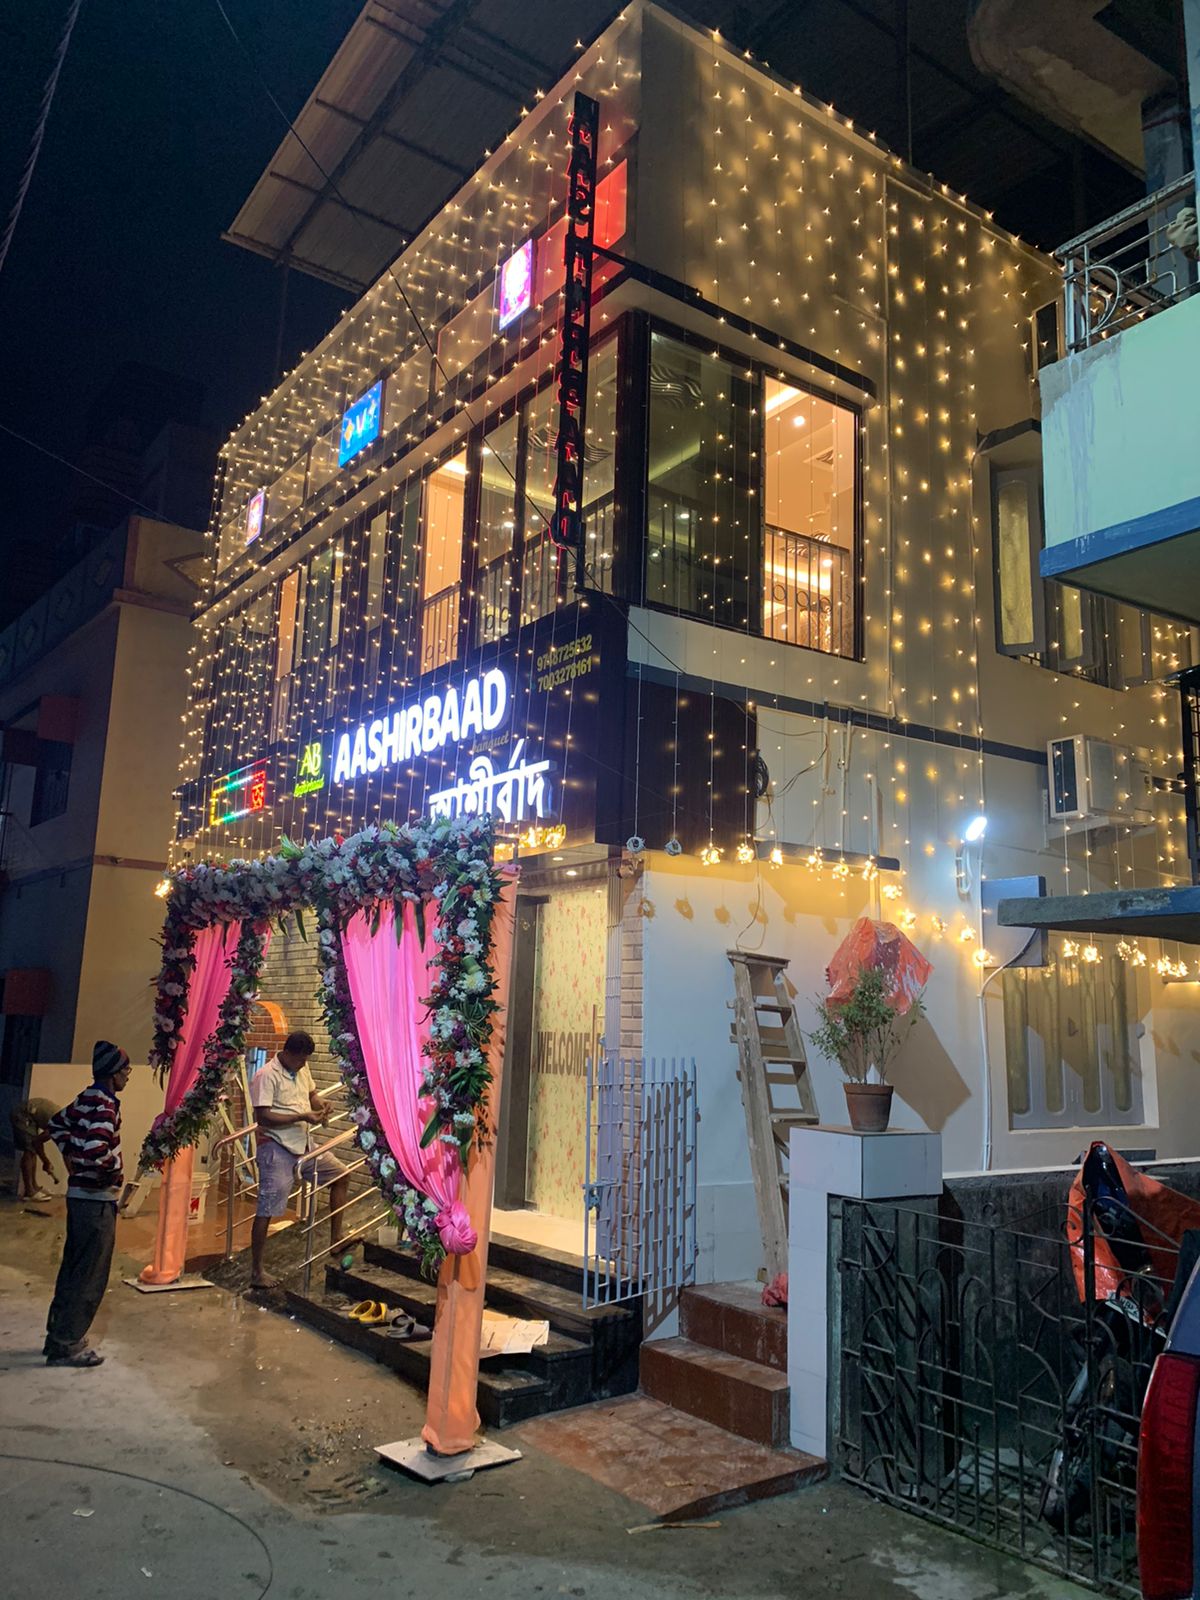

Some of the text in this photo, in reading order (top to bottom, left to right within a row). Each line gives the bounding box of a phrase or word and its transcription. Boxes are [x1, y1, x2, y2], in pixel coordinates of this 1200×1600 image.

[537, 656, 593, 693] 7003278161
[333, 668, 507, 784] AASHIRBAAD
[299, 742, 322, 777] AB
[537, 1031, 591, 1077] WELCOME
